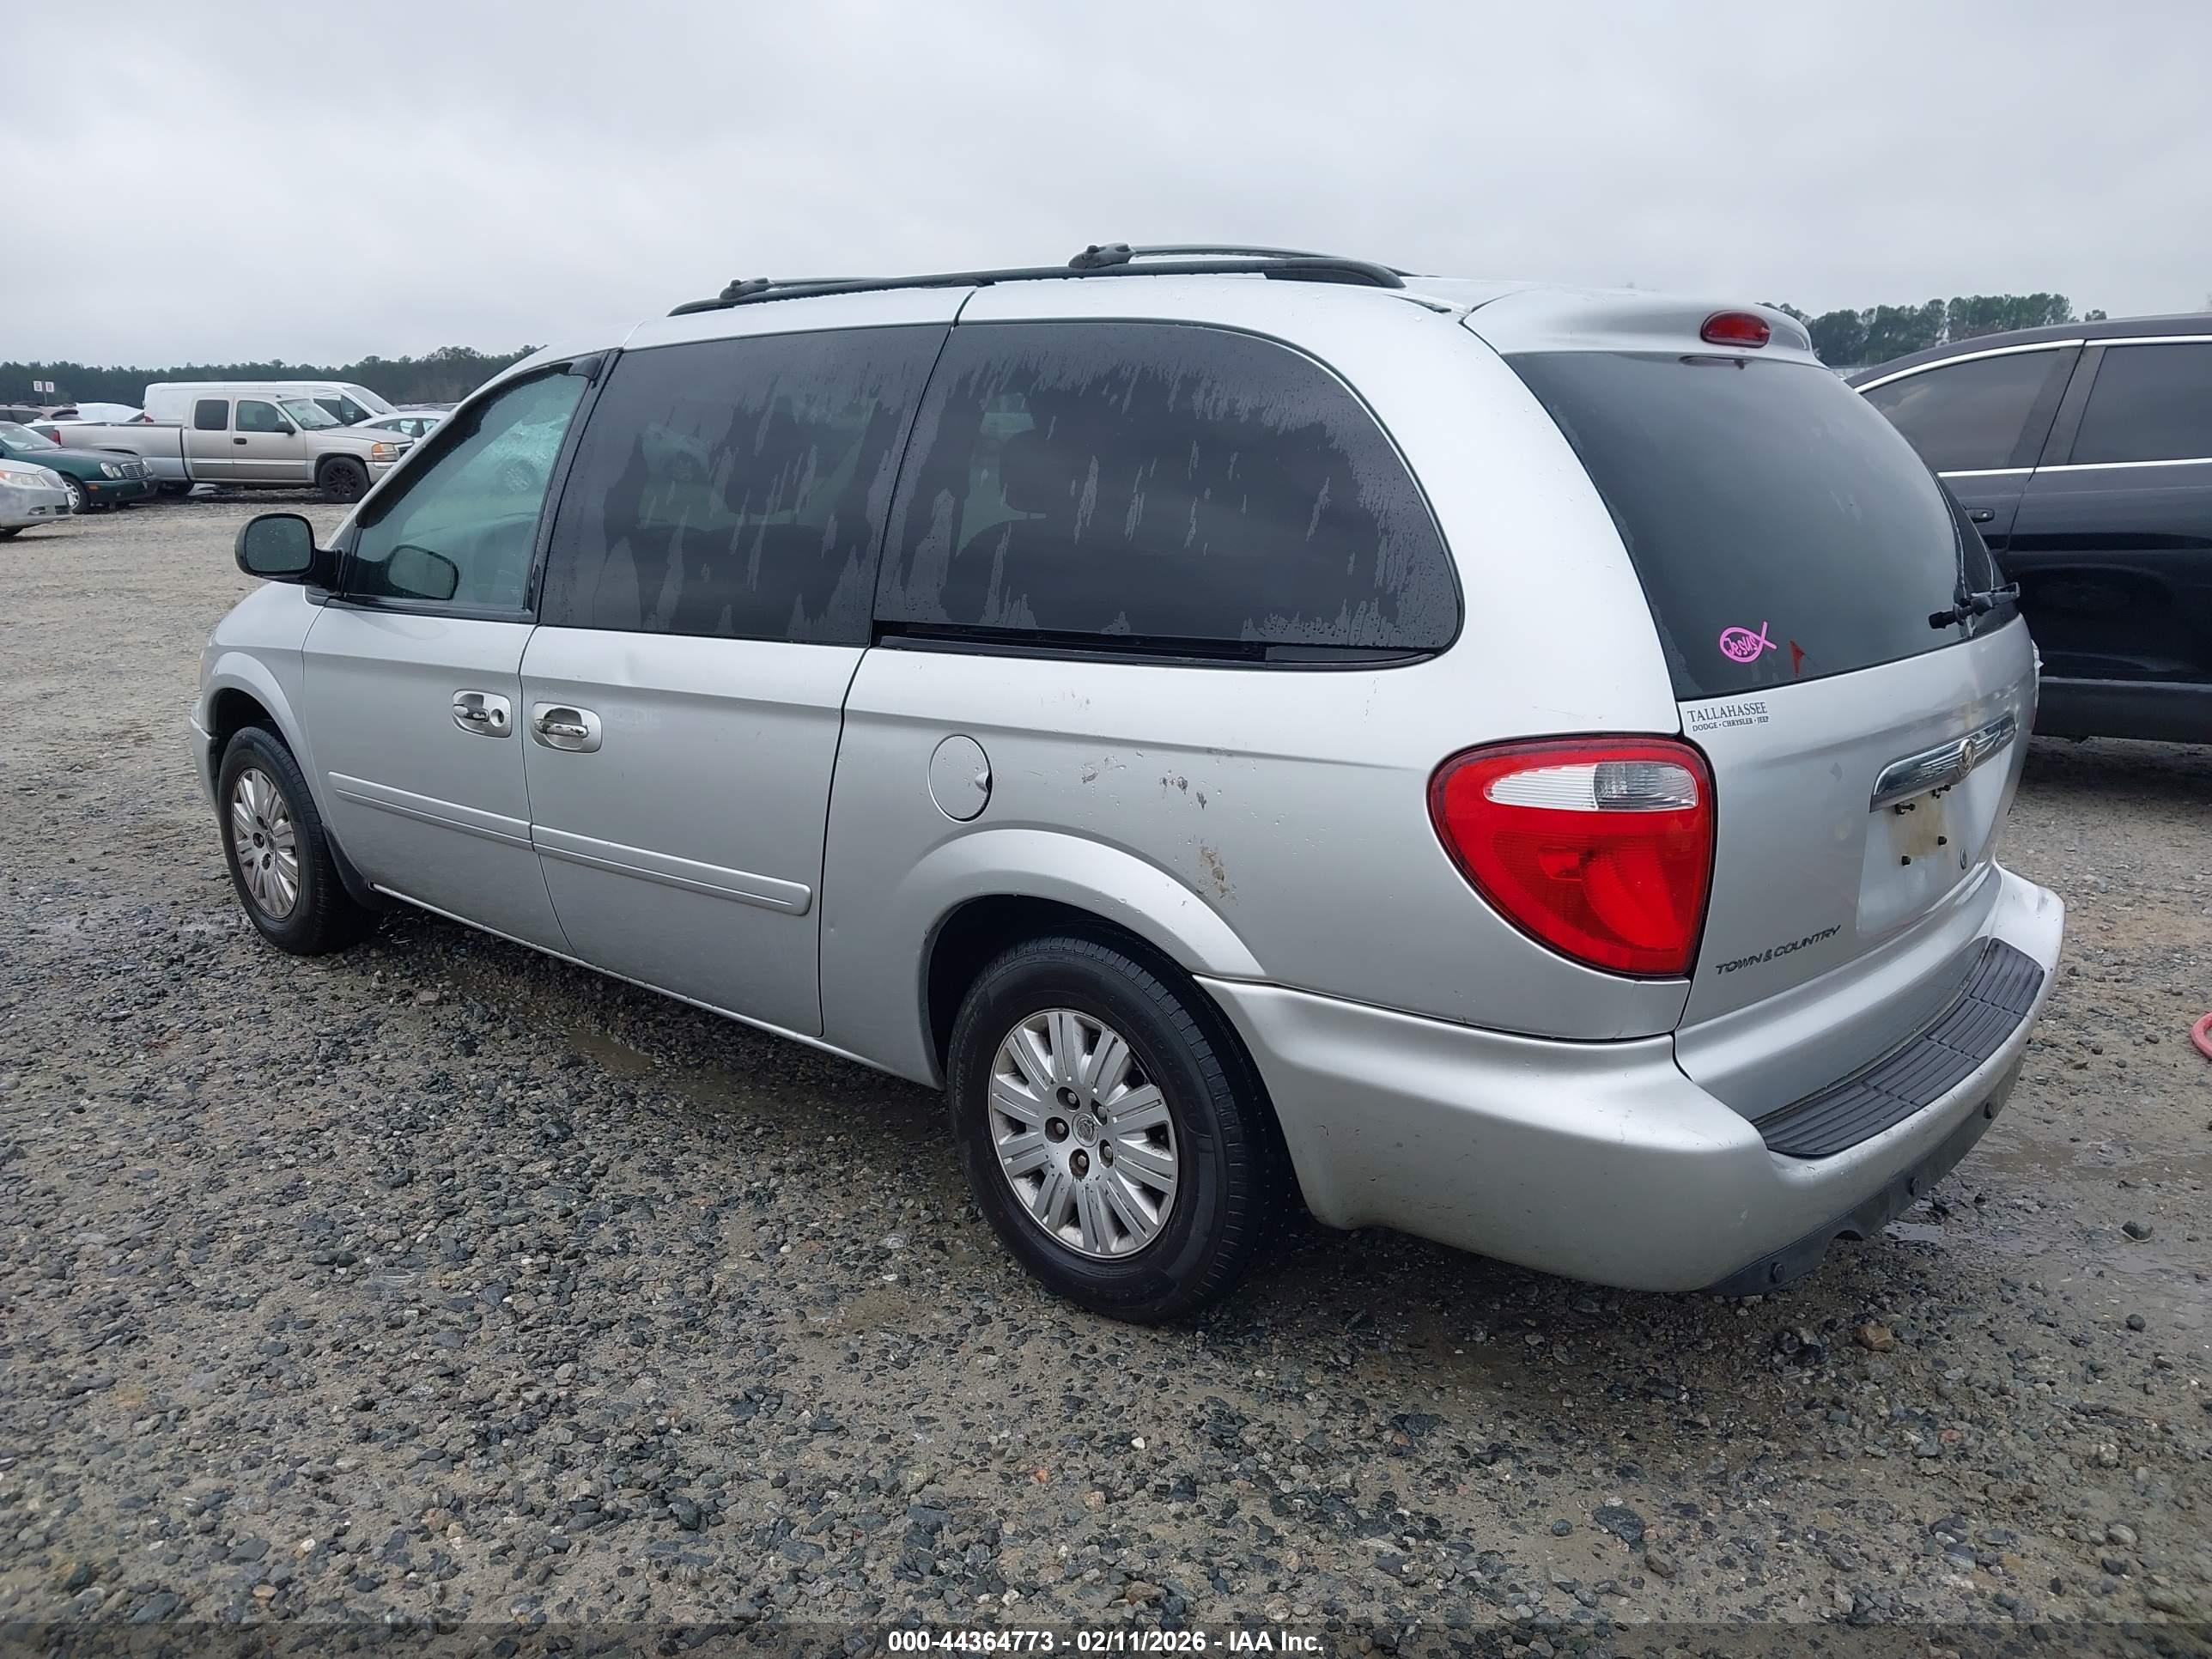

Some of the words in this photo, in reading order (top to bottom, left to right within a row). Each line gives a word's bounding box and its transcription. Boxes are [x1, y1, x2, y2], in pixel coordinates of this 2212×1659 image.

[1686, 702, 1768, 723] TALLAHASSEE
[1692, 722, 1718, 732] DODGE
[1722, 717, 1753, 728] CHRYSLER
